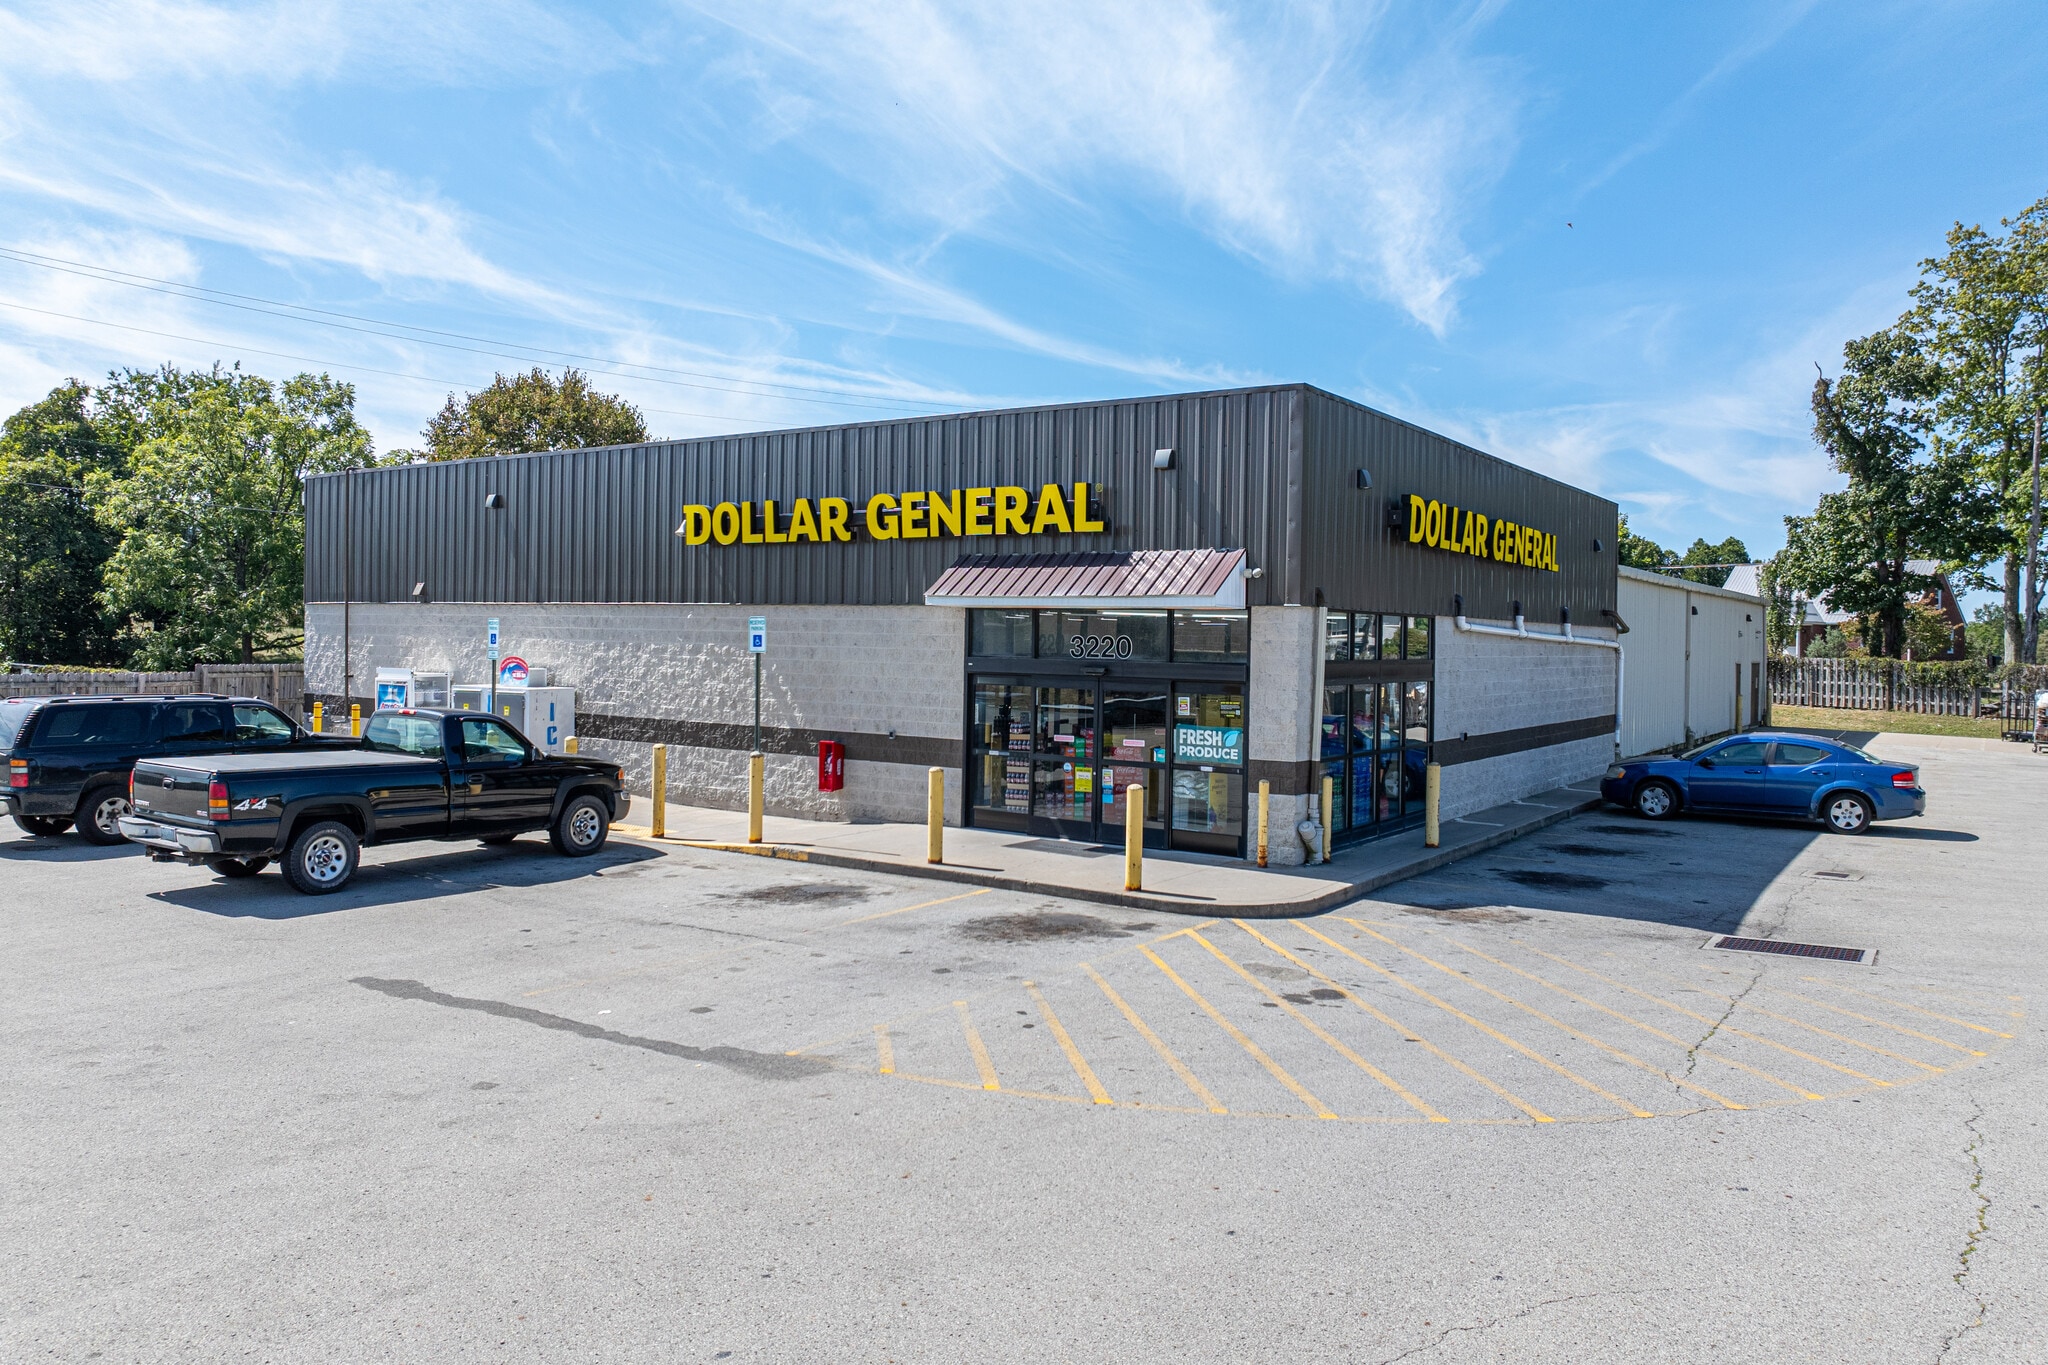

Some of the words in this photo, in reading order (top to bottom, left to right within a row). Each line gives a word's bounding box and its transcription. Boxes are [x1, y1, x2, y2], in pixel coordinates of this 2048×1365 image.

[683, 497, 851, 546] DOLLAR
[867, 482, 1104, 541] GENERAL
[1409, 494, 1488, 558] DOLLAR
[1493, 518, 1559, 572] GENERAL
[1070, 634, 1132, 660] 3220
[1179, 728, 1222, 746] FRESH
[1179, 745, 1239, 760] PRODUCE
